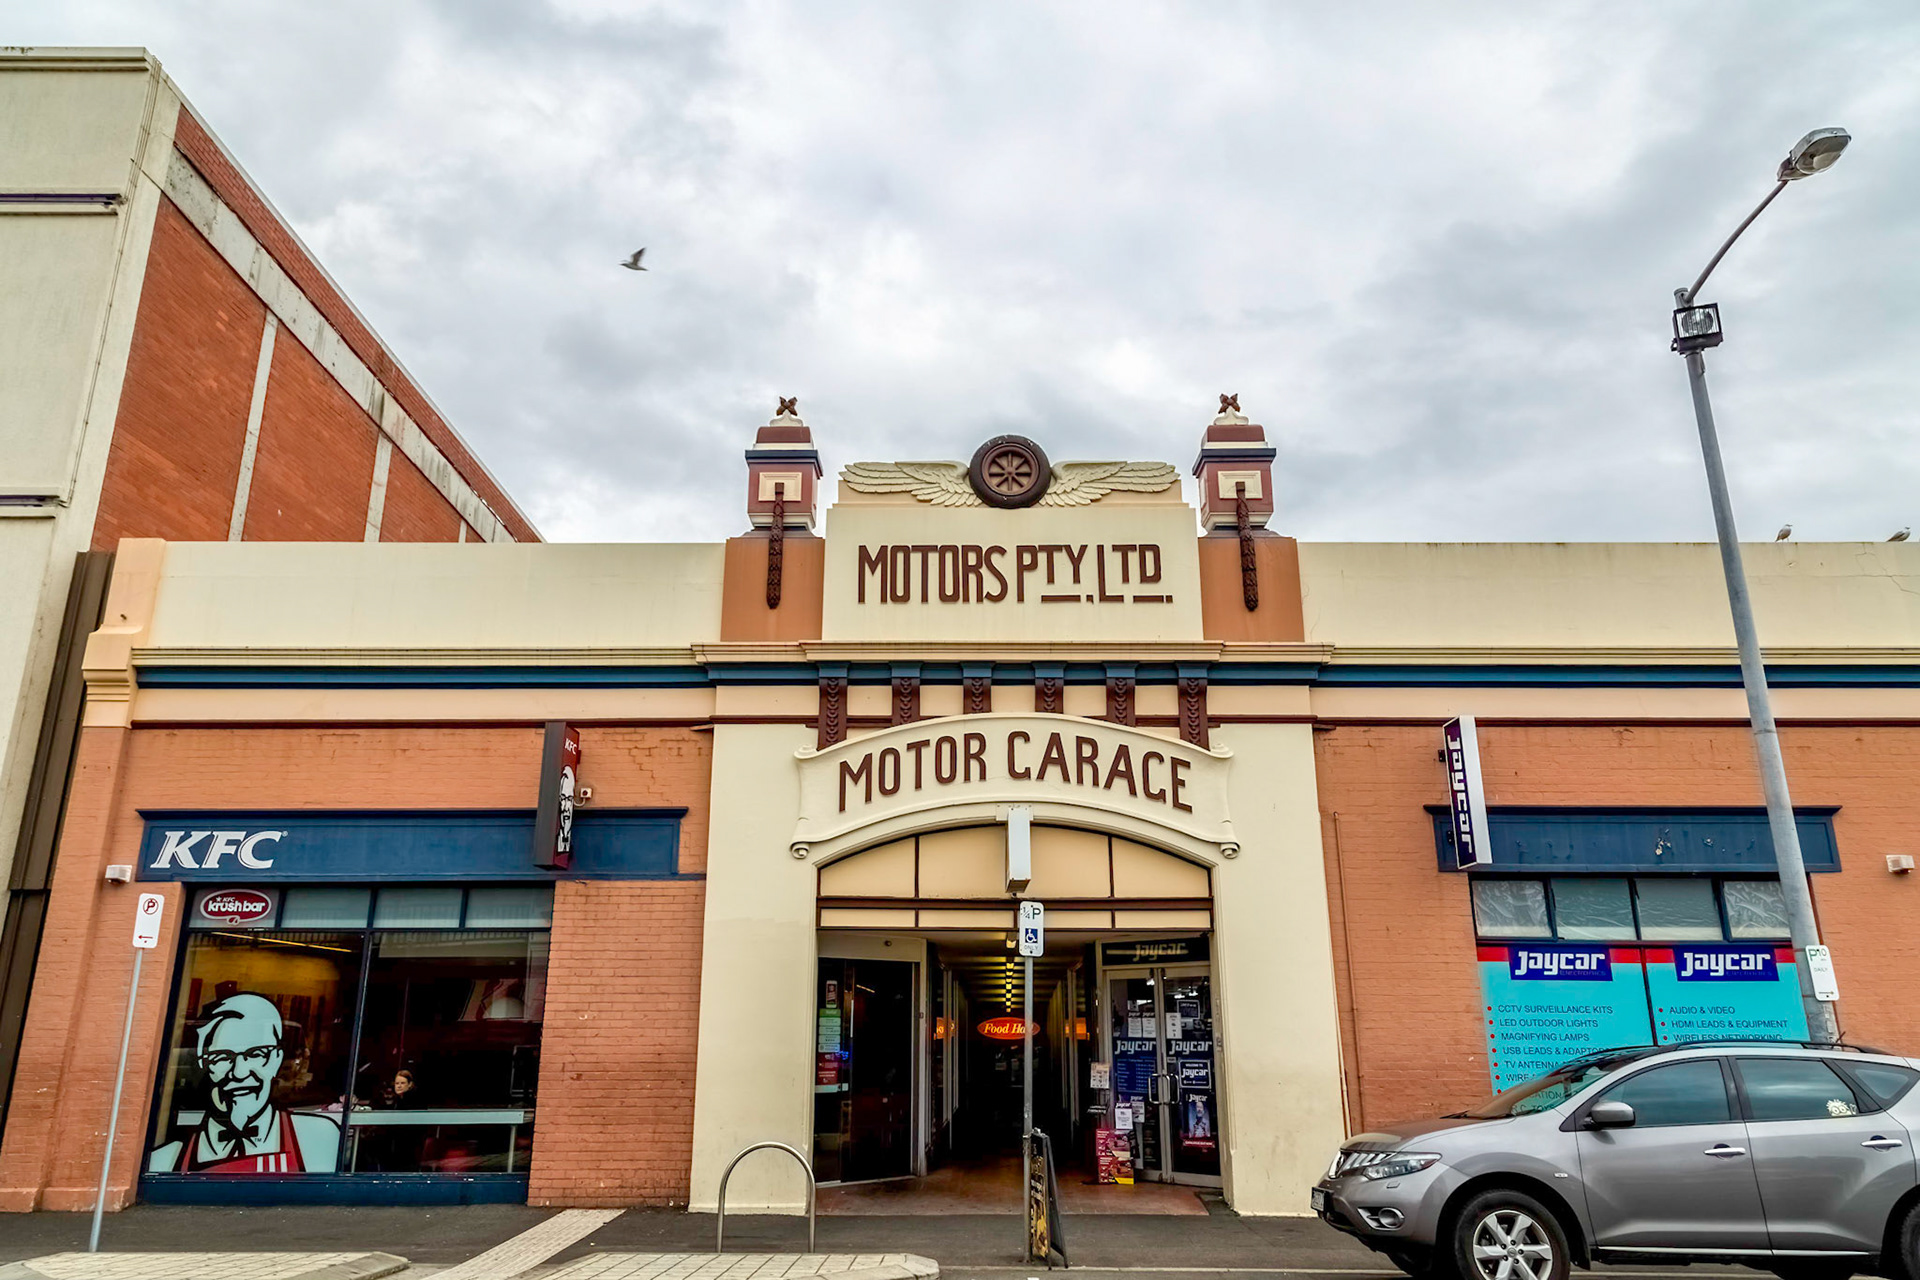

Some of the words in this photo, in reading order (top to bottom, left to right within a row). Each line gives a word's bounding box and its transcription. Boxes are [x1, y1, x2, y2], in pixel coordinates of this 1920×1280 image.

[858, 545, 1008, 604] MOTORS
[565, 737, 577, 754] KFC
[838, 732, 987, 813] MOTOR
[1007, 730, 1193, 813] GARAGE
[150, 830, 283, 869] KFC
[207, 900, 242, 912] krush
[243, 900, 266, 912] bar
[1032, 907, 1042, 919] P
[1498, 1005, 1522, 1013] CCTV
[1524, 1005, 1591, 1014] SURVEILLANCE
[1593, 1006, 1613, 1014] KITS
[1669, 1006, 1697, 1014] AUDIO
[984, 1022, 1010, 1034] Food
[1499, 1019, 1517, 1027] LED
[1519, 1019, 1564, 1027] OUTDOOR
[1566, 1020, 1599, 1028] LIGHTS
[1671, 1020, 1694, 1028] HDMI
[1696, 1020, 1726, 1028] LEADS
[1728, 1020, 1734, 1028] &
[1736, 1020, 1788, 1028] EQUIPMENT
[1501, 1033, 1557, 1041] MAGNIFYING
[1559, 1033, 1590, 1042] LAMPS
[1523, 1047, 1553, 1055] LEADS
[1555, 1047, 1561, 1055] &
